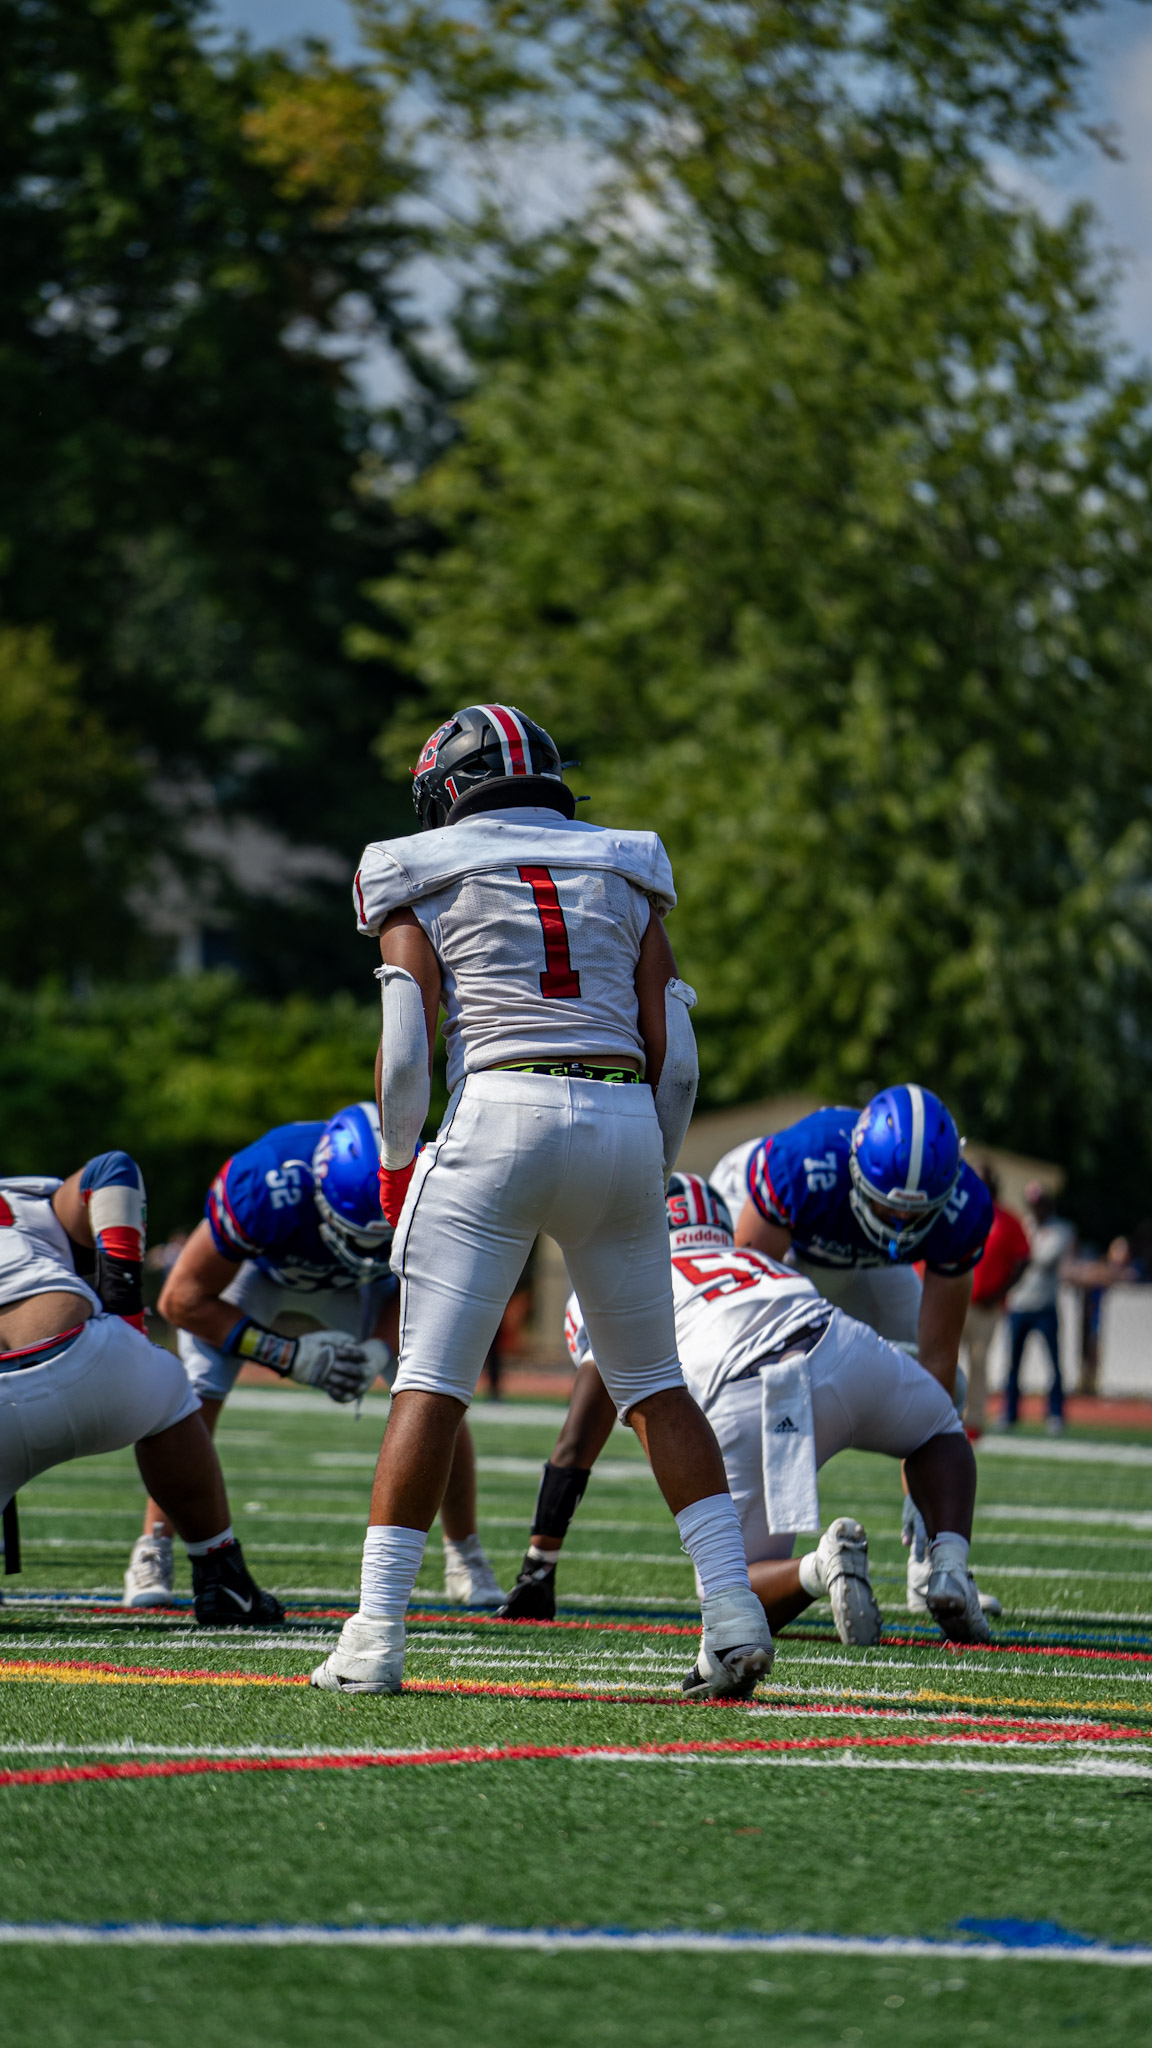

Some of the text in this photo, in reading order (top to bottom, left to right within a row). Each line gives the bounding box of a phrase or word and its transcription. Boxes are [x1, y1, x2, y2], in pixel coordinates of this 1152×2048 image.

[444, 776, 460, 804] 1
[517, 865, 582, 999] 1
[265, 1168, 302, 1210] 52
[803, 1151, 838, 1193] 72
[676, 1229, 730, 1248] Riddell
